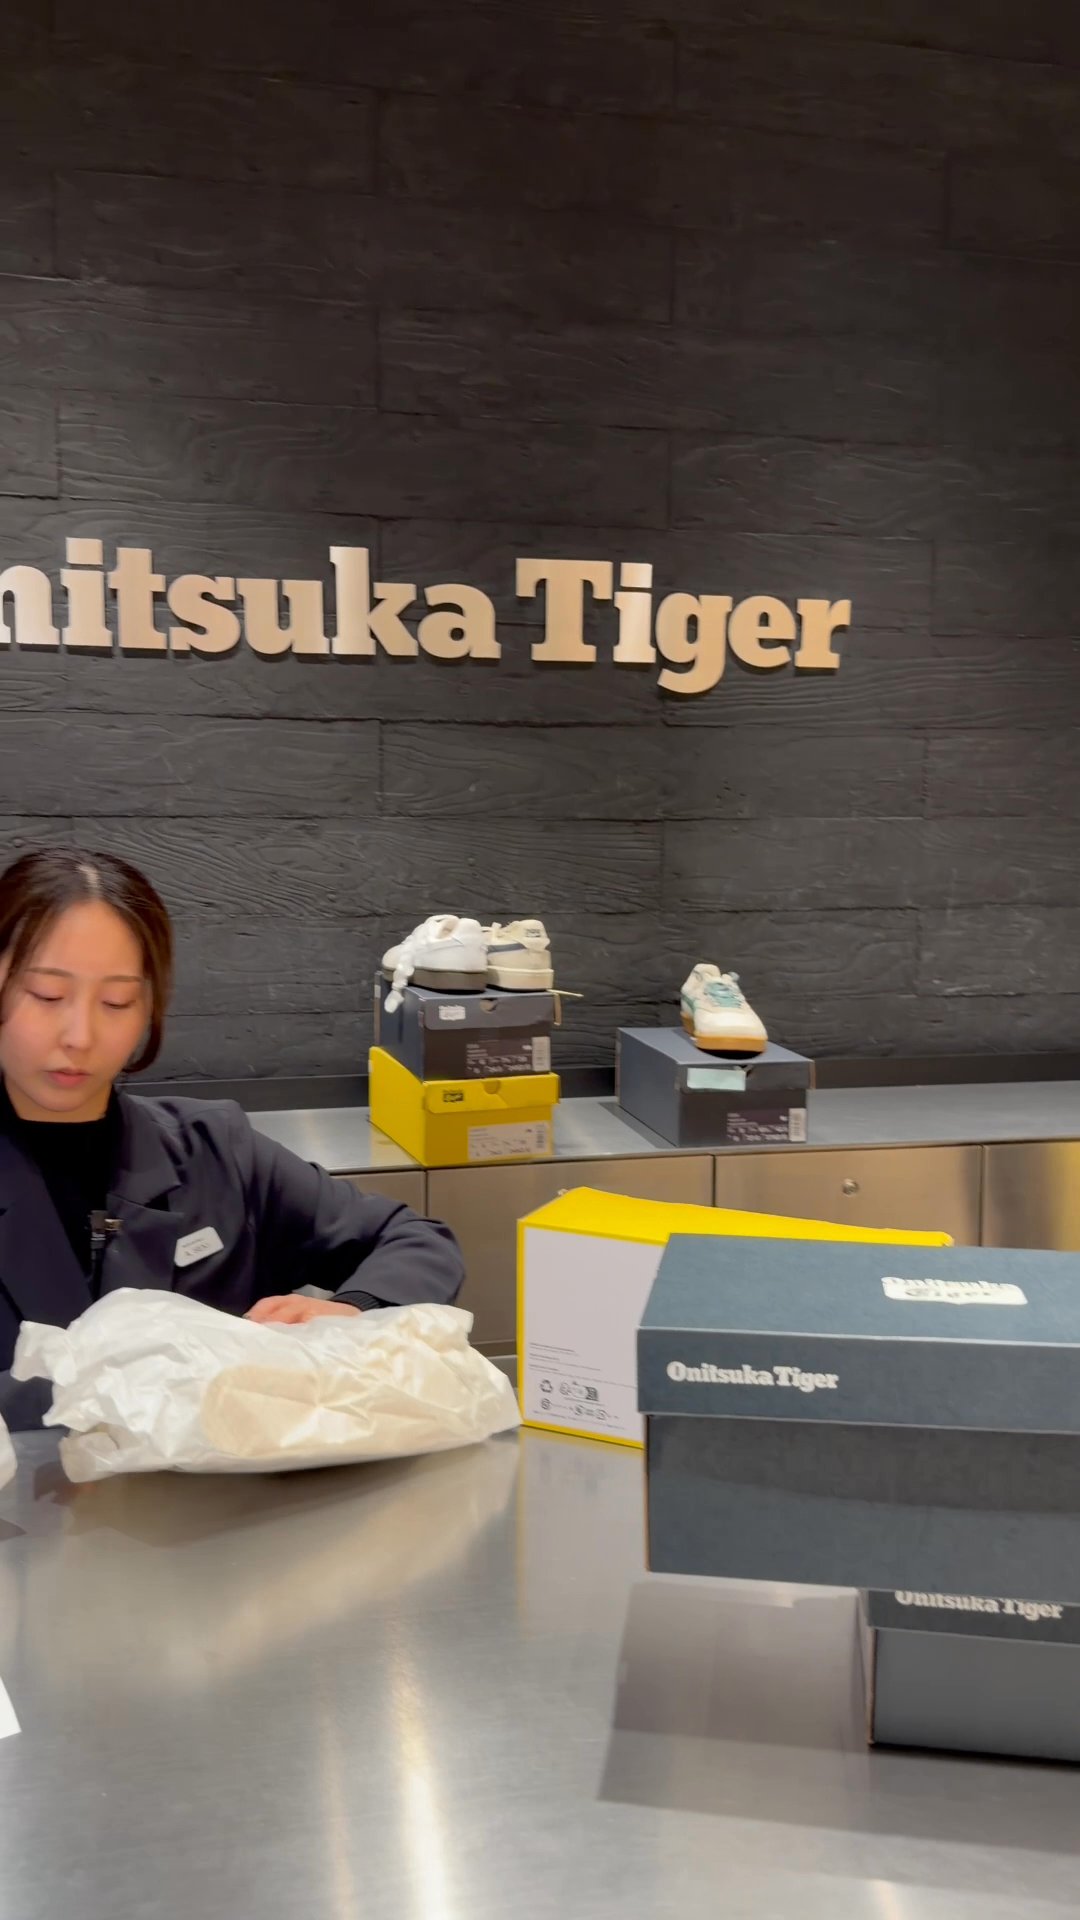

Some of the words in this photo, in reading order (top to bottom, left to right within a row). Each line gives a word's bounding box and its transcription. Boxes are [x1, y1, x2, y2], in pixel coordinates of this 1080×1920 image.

[516, 558, 852, 694] Tiger
[667, 1361, 774, 1385] Onitsuka
[774, 1366, 839, 1392] Tiger
